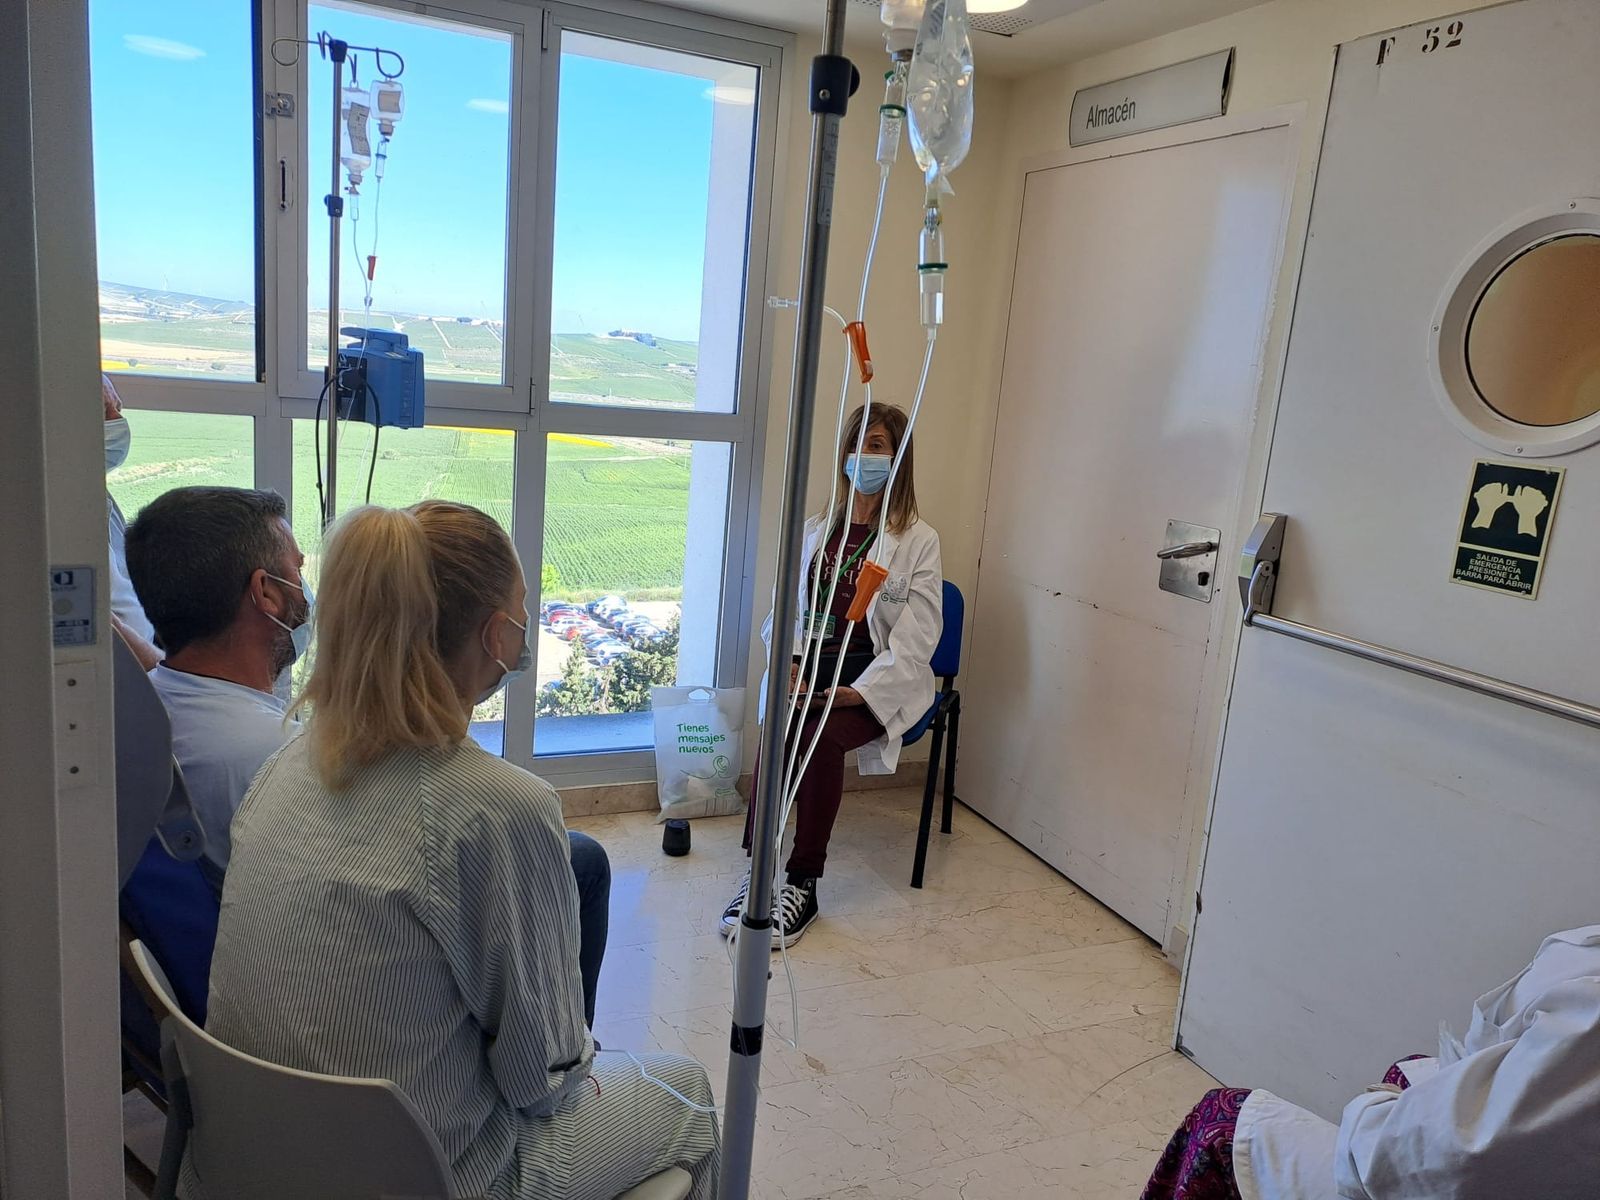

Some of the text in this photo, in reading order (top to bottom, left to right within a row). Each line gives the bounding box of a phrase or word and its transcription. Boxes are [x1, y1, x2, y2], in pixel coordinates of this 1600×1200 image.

[1376, 21, 1464, 65] F 52
[1086, 97, 1136, 130] Almacén
[1469, 558, 1521, 574] EMERGENCIA
[1476, 553, 1518, 567] SALIDA DE
[1468, 565, 1507, 578] PRESIONE
[1455, 568, 1532, 590] BARRA PARA ABRIR
[677, 723, 710, 733] Tienes
[678, 734, 726, 744] mensajes
[679, 745, 714, 753] nuevos
